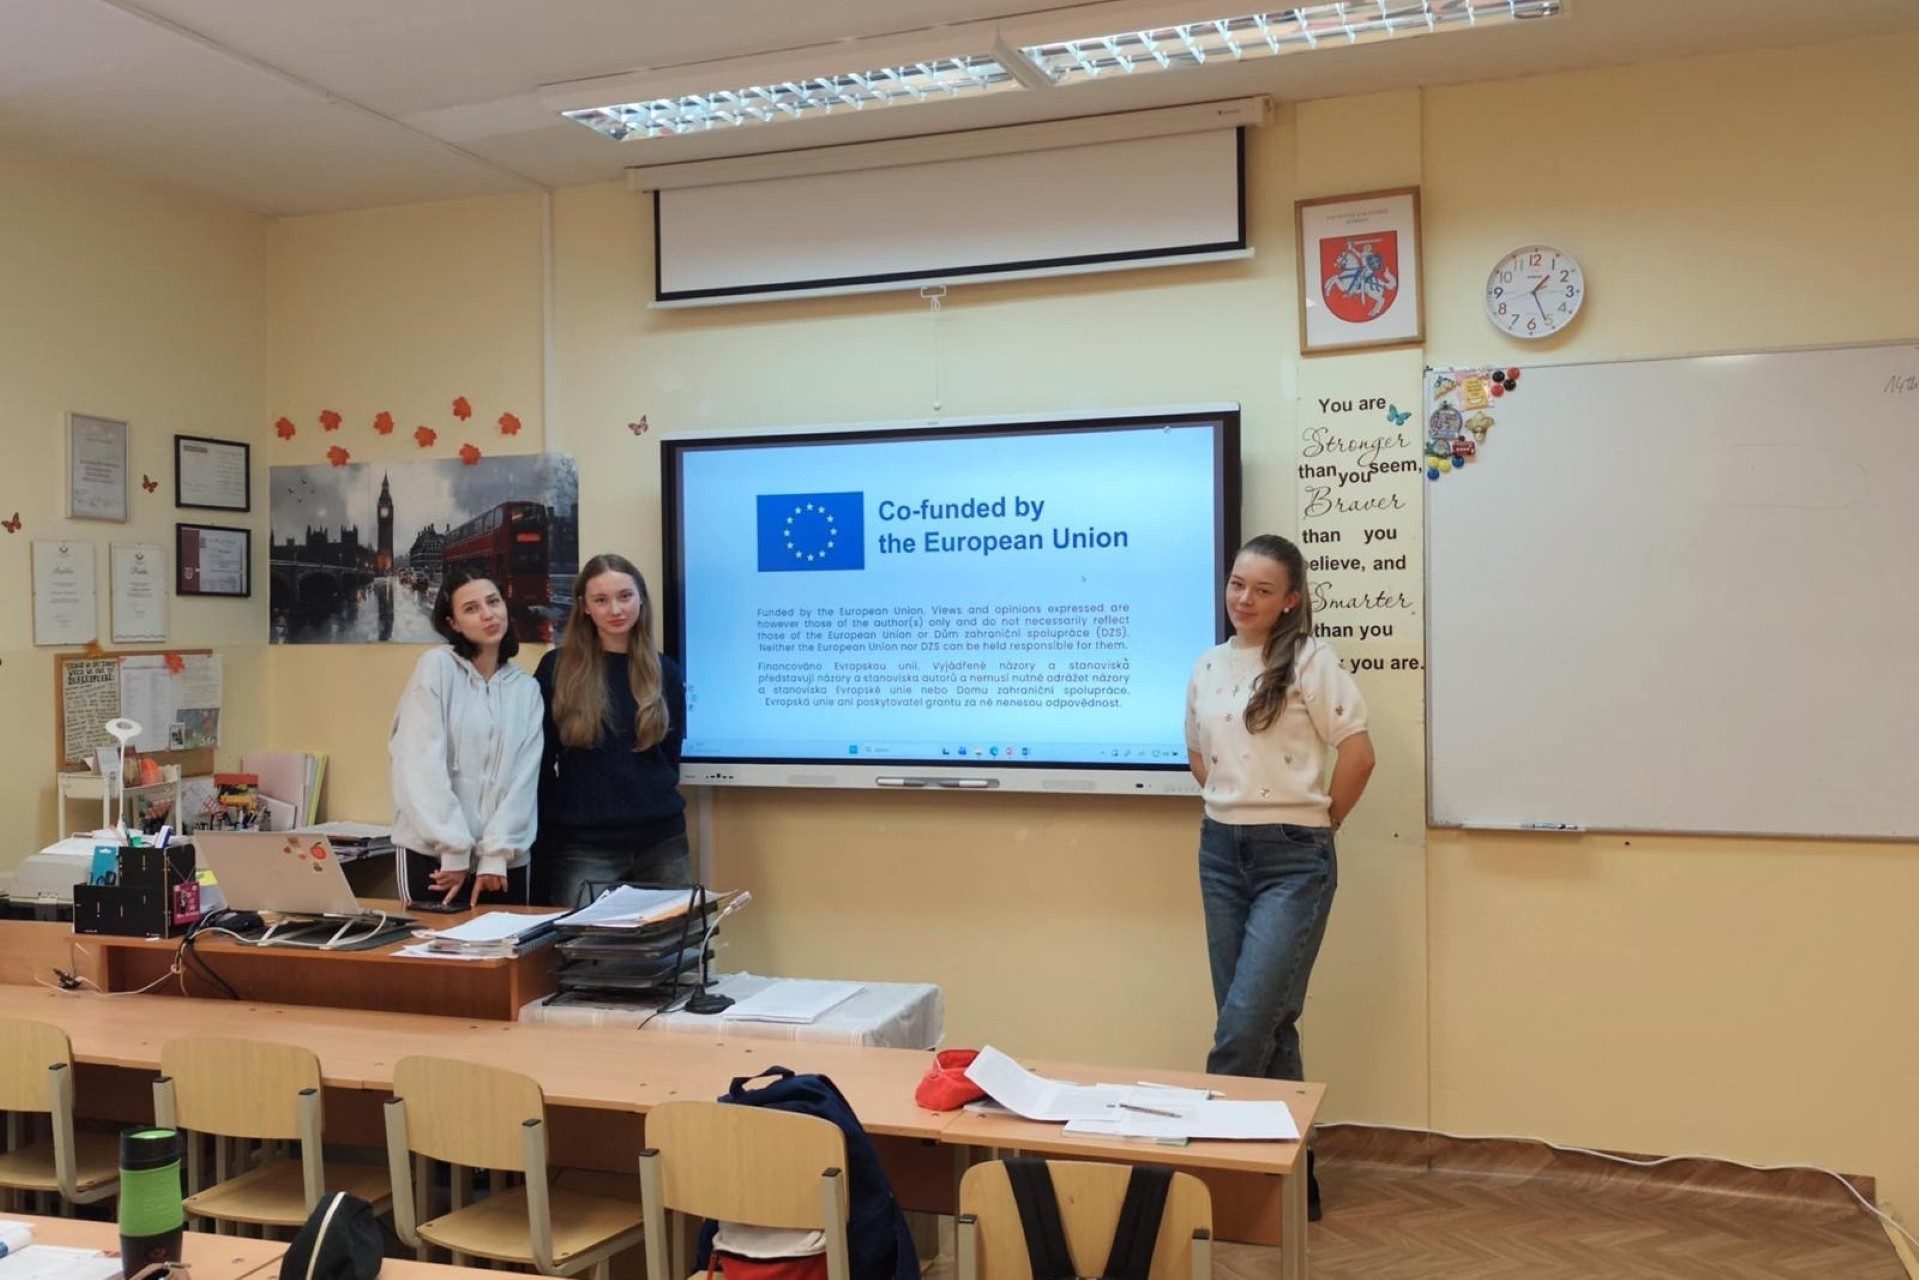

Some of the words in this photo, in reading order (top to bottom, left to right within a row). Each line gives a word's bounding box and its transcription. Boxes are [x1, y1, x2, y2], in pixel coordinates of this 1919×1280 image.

[1529, 254, 1542, 266] 12
[1499, 271, 1512, 283] 10
[1560, 269, 1569, 283] 2
[1493, 287, 1504, 299] 9
[1565, 285, 1574, 297] 3
[1498, 302, 1507, 315] 8
[1557, 302, 1567, 313] 4
[1509, 313, 1520, 330] 7
[1527, 317, 1537, 330] 6
[1318, 398, 1353, 414] You
[1359, 397, 1387, 411] are
[1302, 426, 1411, 467] Stronger
[1298, 464, 1337, 479] than
[1338, 470, 1371, 487] you
[1369, 459, 1422, 474] seem,
[878, 496, 1006, 521] Co-funded
[1015, 496, 1045, 522] by
[1303, 485, 1407, 520] Braver
[878, 533, 916, 554] the
[924, 531, 1044, 556] European
[1053, 526, 1129, 549] Union
[1302, 529, 1341, 544] than
[1364, 528, 1397, 545] you
[1373, 555, 1406, 571] and
[1308, 581, 1413, 613] Smarter
[757, 607, 794, 617] Funded
[799, 607, 812, 619] by
[817, 606, 834, 616] the
[839, 606, 888, 618] European
[931, 605, 962, 615] Views
[968, 605, 989, 615] and
[994, 604, 1041, 616] opinions
[1048, 603, 1104, 616] expressed
[1110, 605, 1130, 613] are
[757, 618, 799, 628] however
[804, 618, 832, 628] those
[837, 618, 847, 628] of
[852, 617, 869, 627] the
[874, 617, 923, 629] author(s)
[928, 617, 951, 629] only
[956, 616, 977, 626] and
[982, 616, 996, 626] do
[1001, 616, 1019, 626] not
[1024, 615, 1087, 628] necessarily
[1093, 615, 1130, 625] reflect
[757, 630, 785, 640] those
[790, 630, 800, 640] of
[806, 630, 822, 640] the
[828, 630, 876, 642] European
[882, 629, 912, 639] Union
[917, 631, 928, 639] or
[1314, 623, 1353, 638] than
[1360, 625, 1393, 640] you
[759, 642, 795, 652] Neither
[798, 641, 814, 651] the
[818, 641, 866, 653] European
[868, 641, 898, 651] Union
[901, 643, 917, 651] nor
[921, 641, 940, 651] DZS
[943, 643, 963, 651] can
[966, 640, 980, 650] be
[983, 640, 1006, 650] held
[1010, 640, 1074, 652] responsible
[1077, 640, 1092, 650] for
[834, 660, 886, 672] Evropskou
[1350, 657, 1384, 674] you
[1390, 658, 1425, 670] are.
[854, 674, 861, 682] a
[863, 672, 919, 682] stanoviska
[960, 674, 967, 682] a
[758, 686, 765, 694] a
[774, 684, 827, 694] stanoviska
[890, 684, 912, 694] unie
[921, 684, 948, 694] nebo
[956, 684, 988, 694] Domu
[813, 695, 834, 705] unie
[838, 695, 853, 705] ani
[856, 696, 922, 708] poskytovatel
[925, 696, 961, 708] grantu
[964, 698, 976, 706] za
[996, 699, 1042, 707] nenesou
